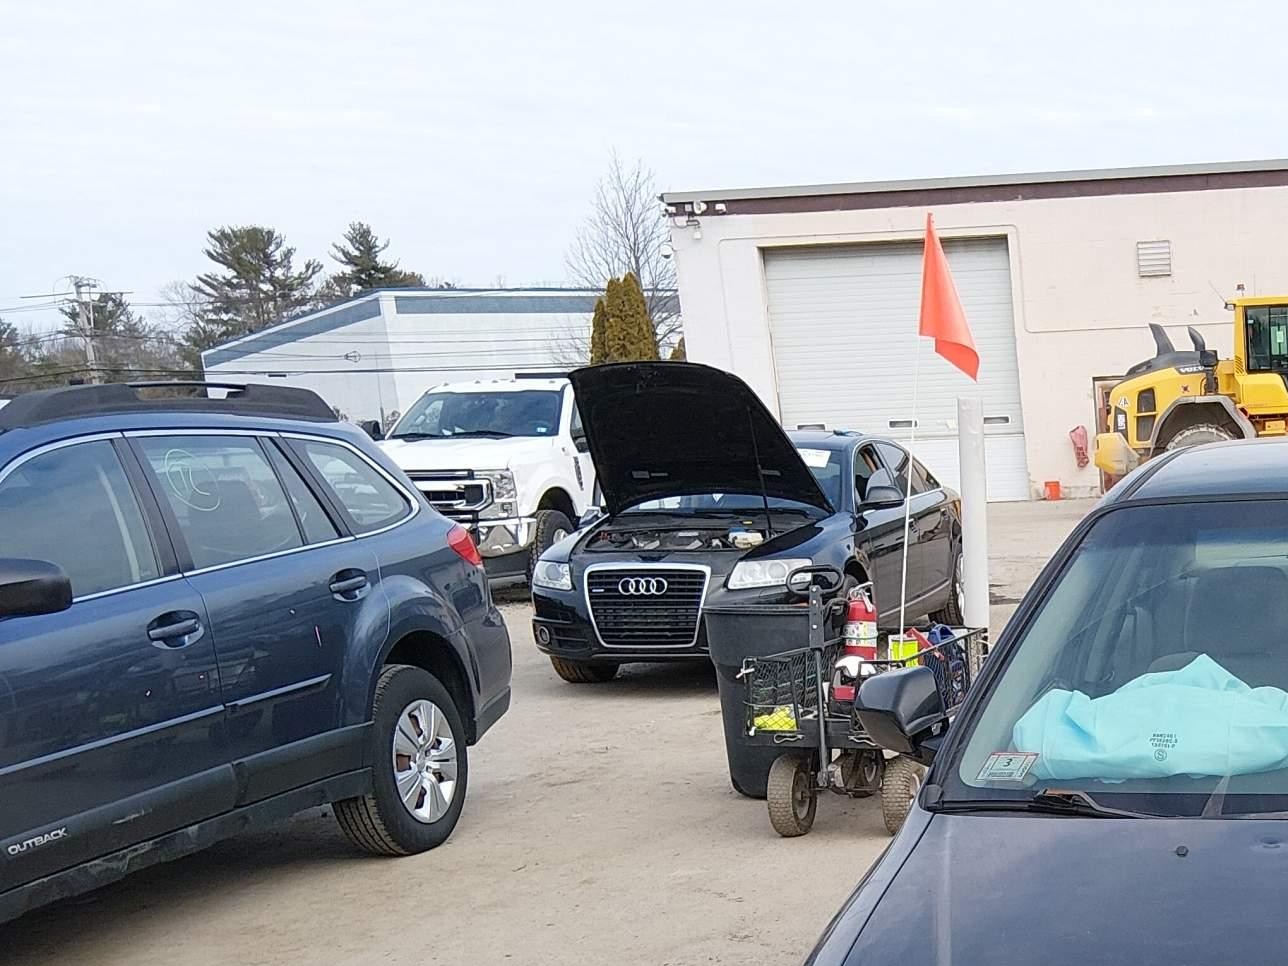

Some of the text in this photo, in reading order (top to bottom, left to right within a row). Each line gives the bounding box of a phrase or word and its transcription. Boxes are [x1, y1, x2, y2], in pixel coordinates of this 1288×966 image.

[1179, 366, 1205, 374] VOLV
[1003, 758, 1013, 767] 3
[7, 827, 68, 855] OUTBACK
